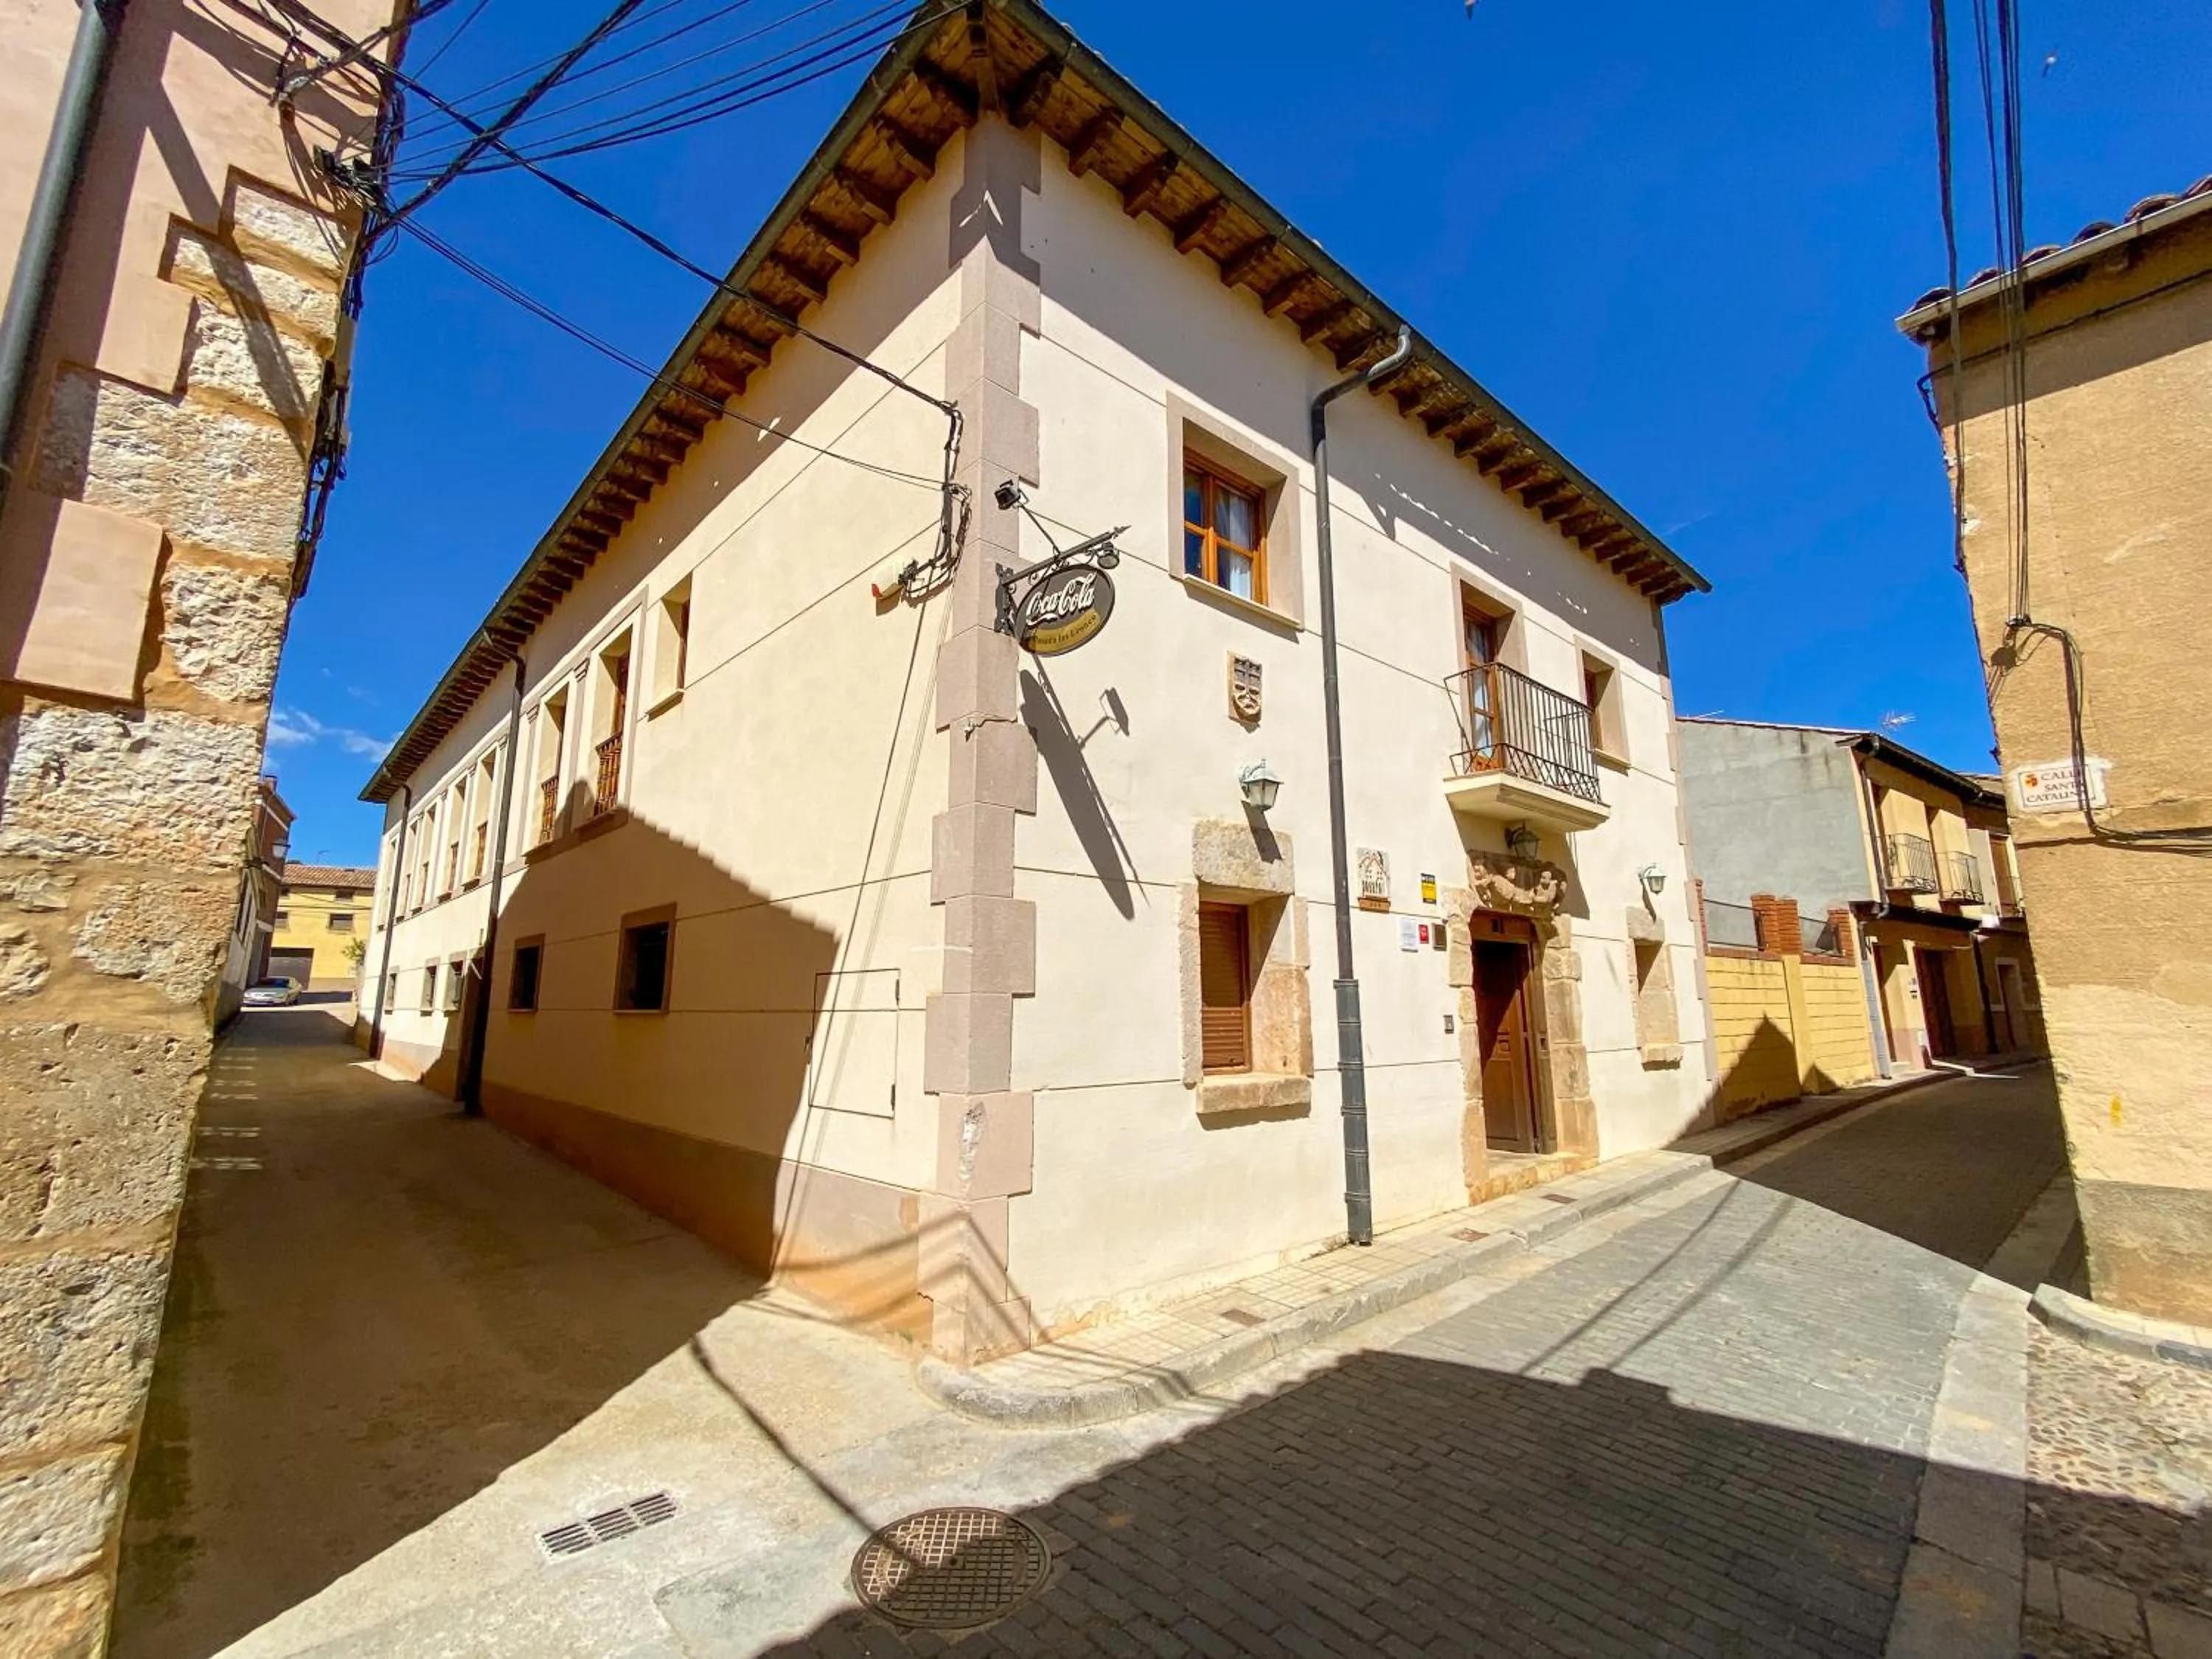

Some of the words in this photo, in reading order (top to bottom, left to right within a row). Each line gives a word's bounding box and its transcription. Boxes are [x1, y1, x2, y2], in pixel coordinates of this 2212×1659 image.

[1026, 571, 1097, 625] Coca-Cola
[2041, 768, 2079, 781] CALL
[2045, 782, 2081, 792] SANT
[2027, 791, 2083, 803] CATALIN
